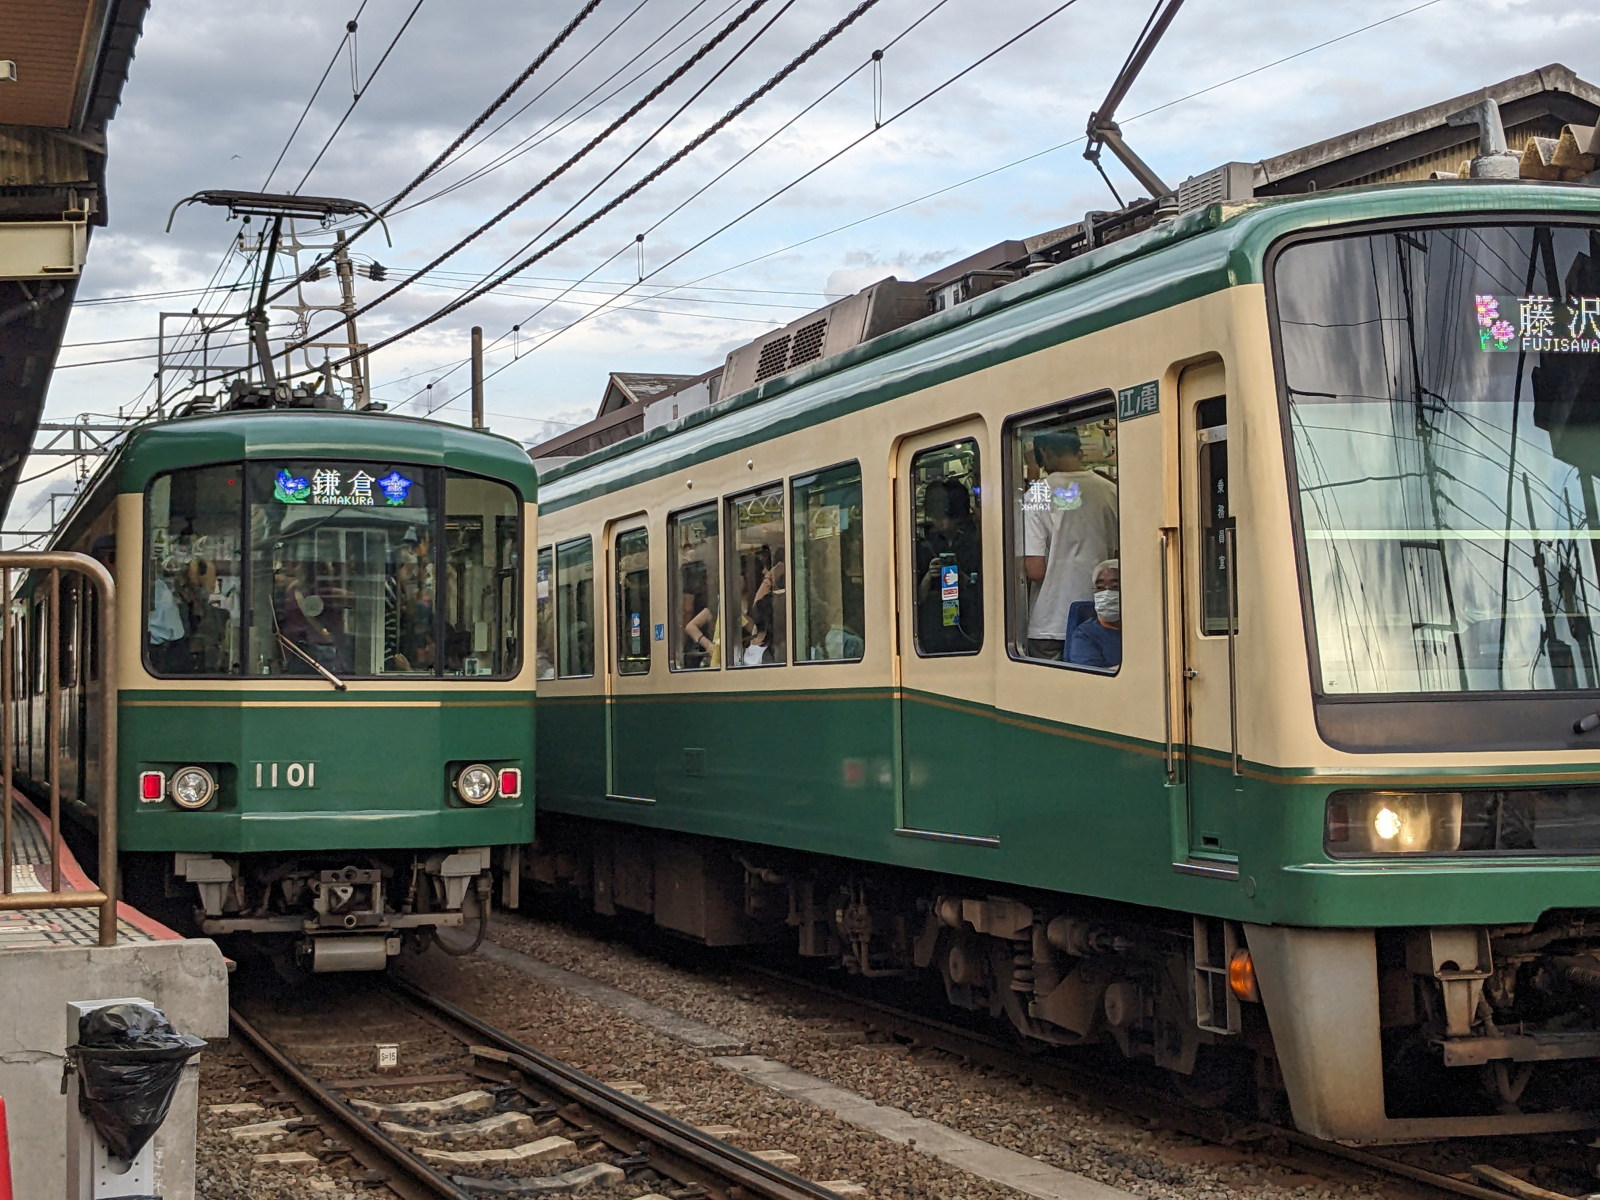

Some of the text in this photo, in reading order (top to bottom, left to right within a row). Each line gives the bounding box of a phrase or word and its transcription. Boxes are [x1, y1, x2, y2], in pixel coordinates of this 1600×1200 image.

[1522, 338, 1600, 352] FUJISAWA
[1120, 384, 1157, 417] 江ノ電
[312, 469, 376, 497] 鎌倉
[314, 496, 374, 505] KAMAKURA
[256, 763, 315, 788] 1101
[381, 1052, 396, 1062] S=15
